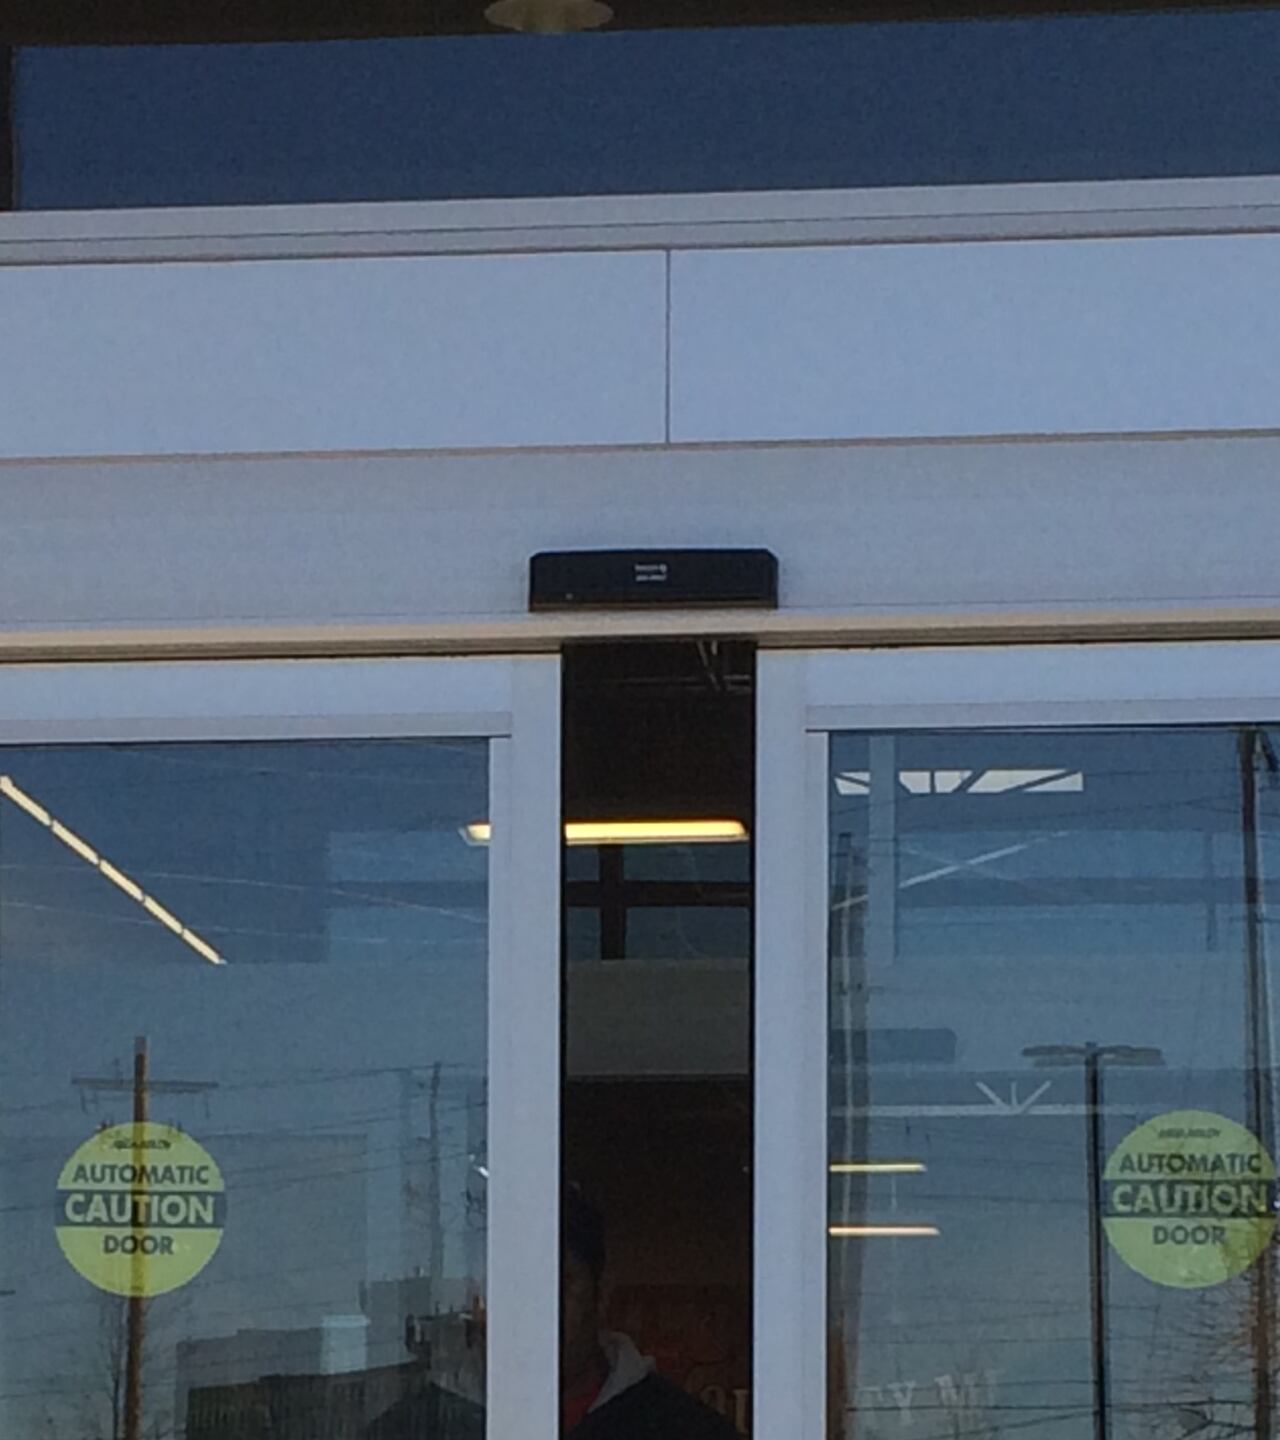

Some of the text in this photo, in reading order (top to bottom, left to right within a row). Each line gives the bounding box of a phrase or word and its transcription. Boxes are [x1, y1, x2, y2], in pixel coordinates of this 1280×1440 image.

[72, 1163, 210, 1185] AUTOMATIC
[1120, 1153, 1262, 1174] AUTOMATIC
[1112, 1182, 1268, 1213] CAUTION
[64, 1193, 214, 1225] CAUTION
[103, 1235, 174, 1255] DOOR
[1153, 1226, 1227, 1245] DOOR
